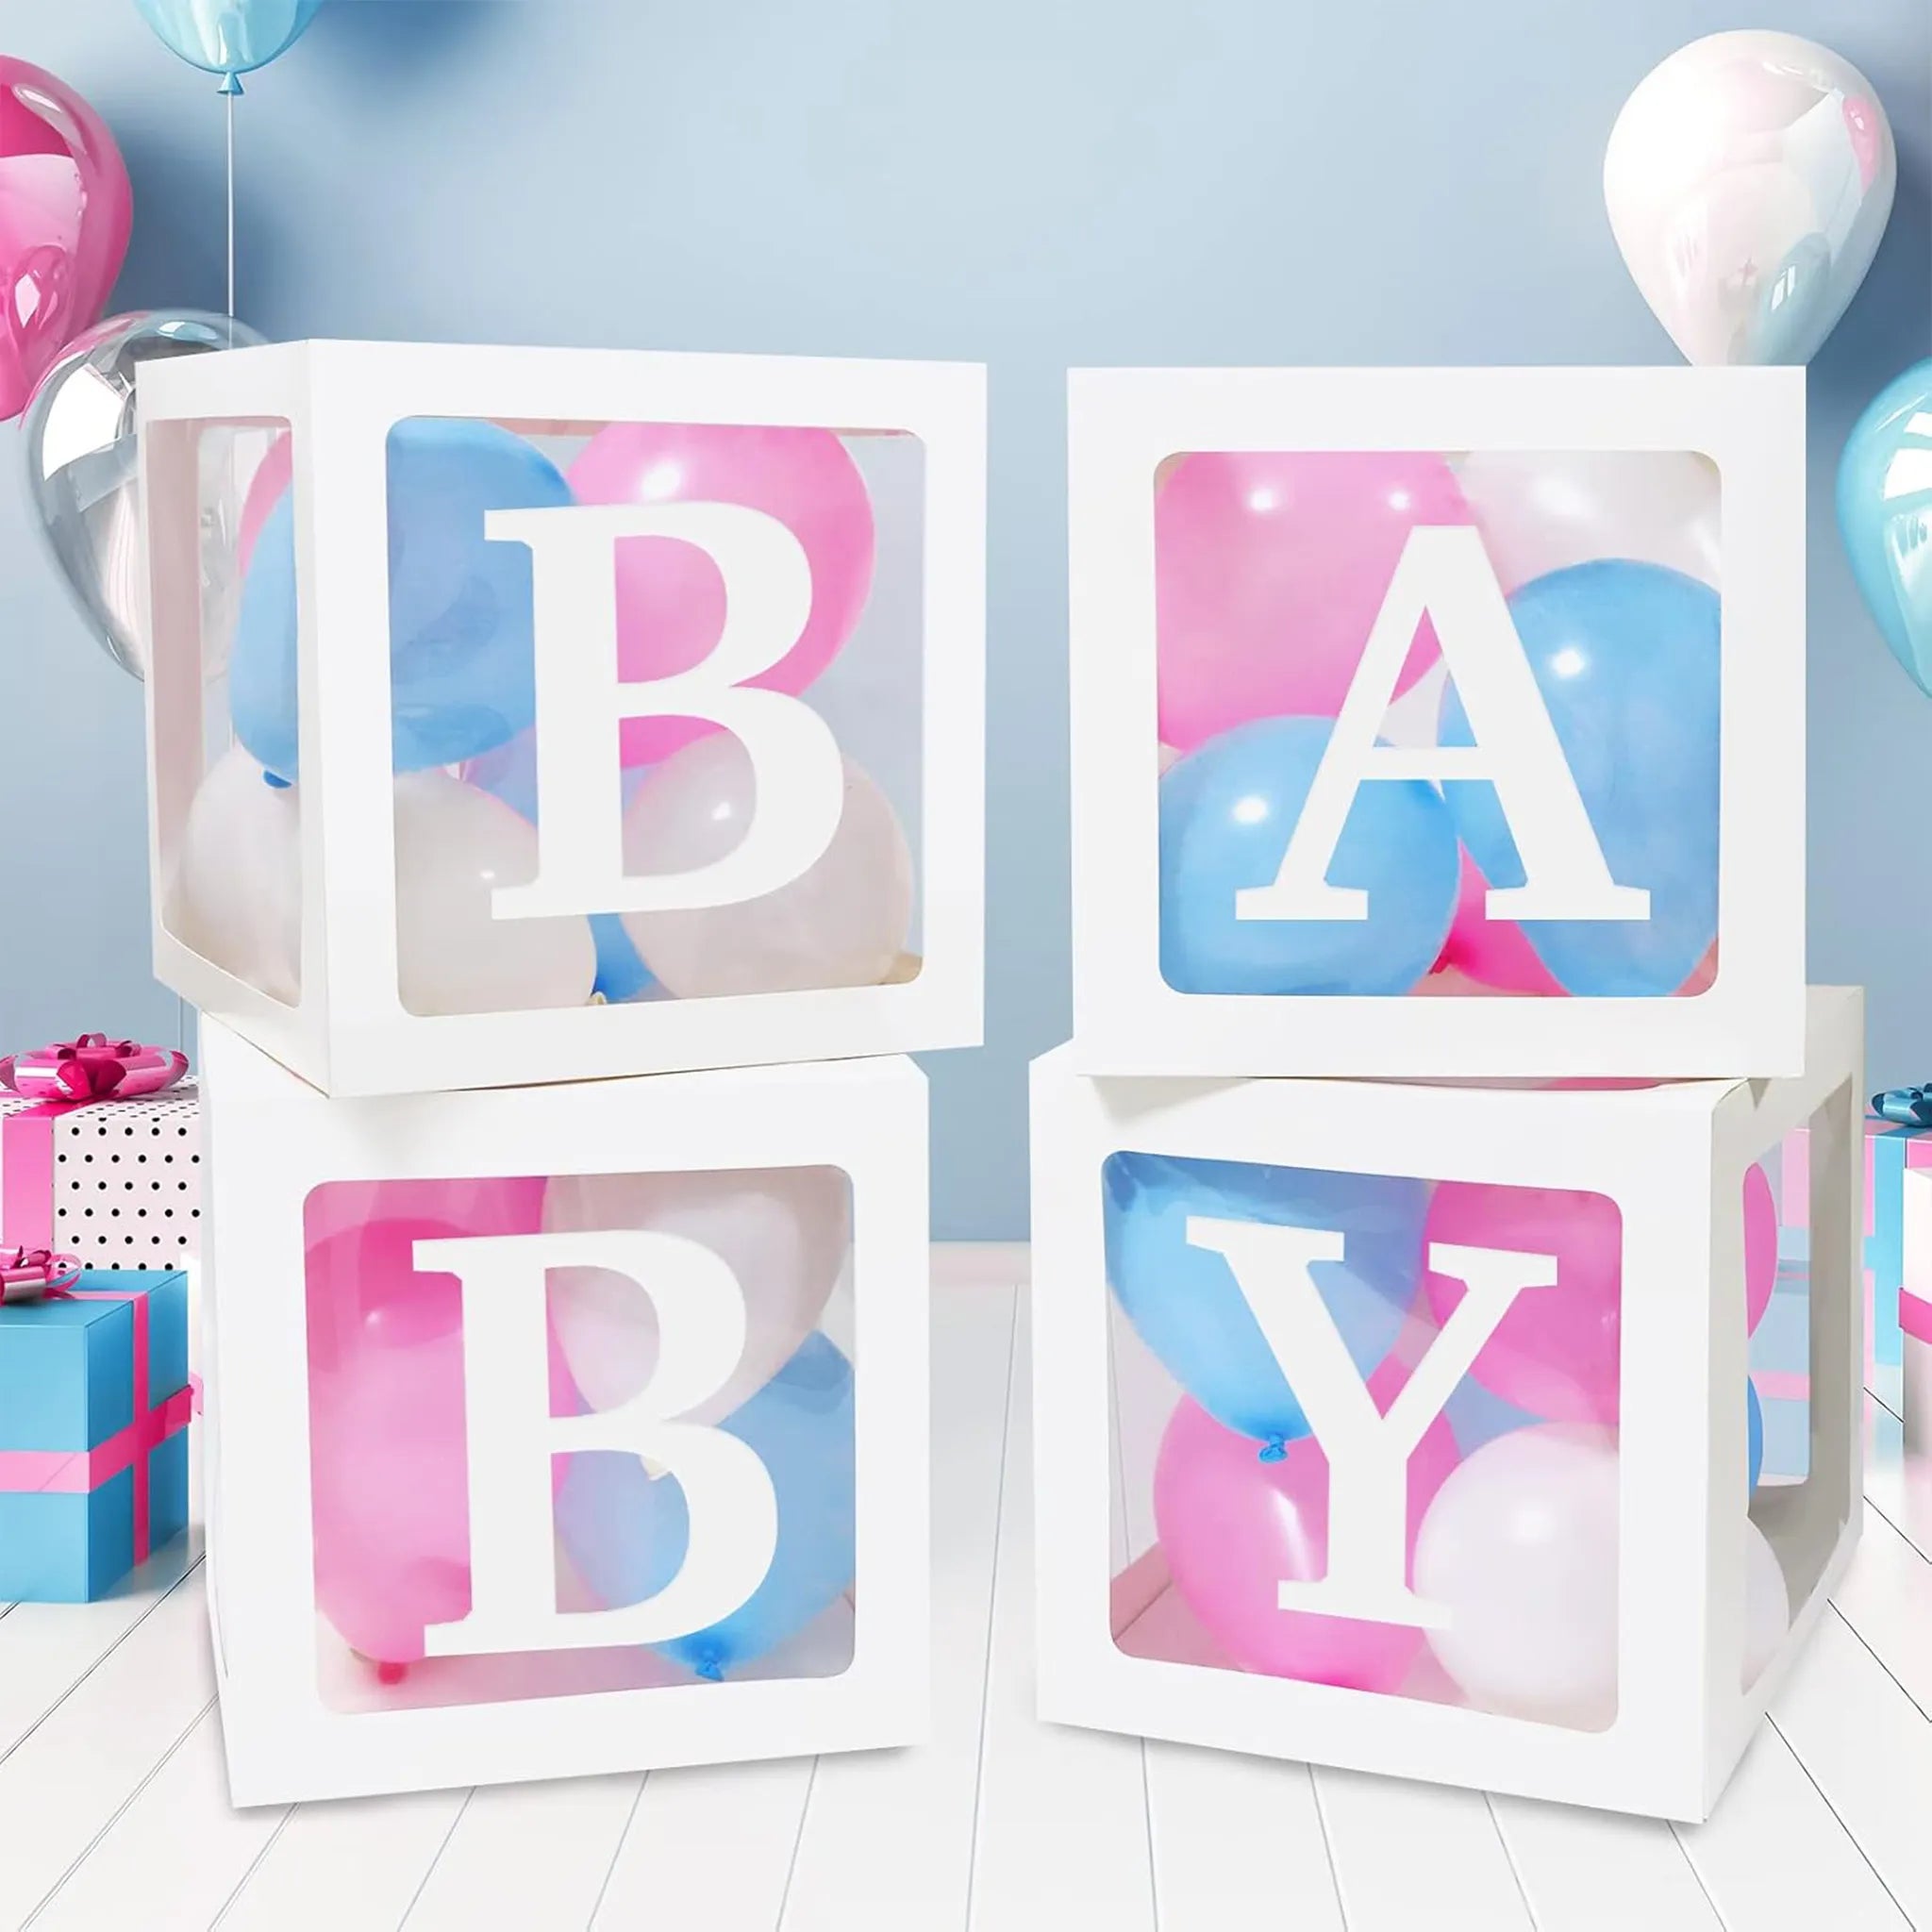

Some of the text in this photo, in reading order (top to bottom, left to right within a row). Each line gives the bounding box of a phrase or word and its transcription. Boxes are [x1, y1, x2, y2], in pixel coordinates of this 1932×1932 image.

[484, 502, 844, 920] B
[1235, 525, 1651, 921] A
[412, 1229, 779, 1657] B
[1186, 1217, 1558, 1630] Y
